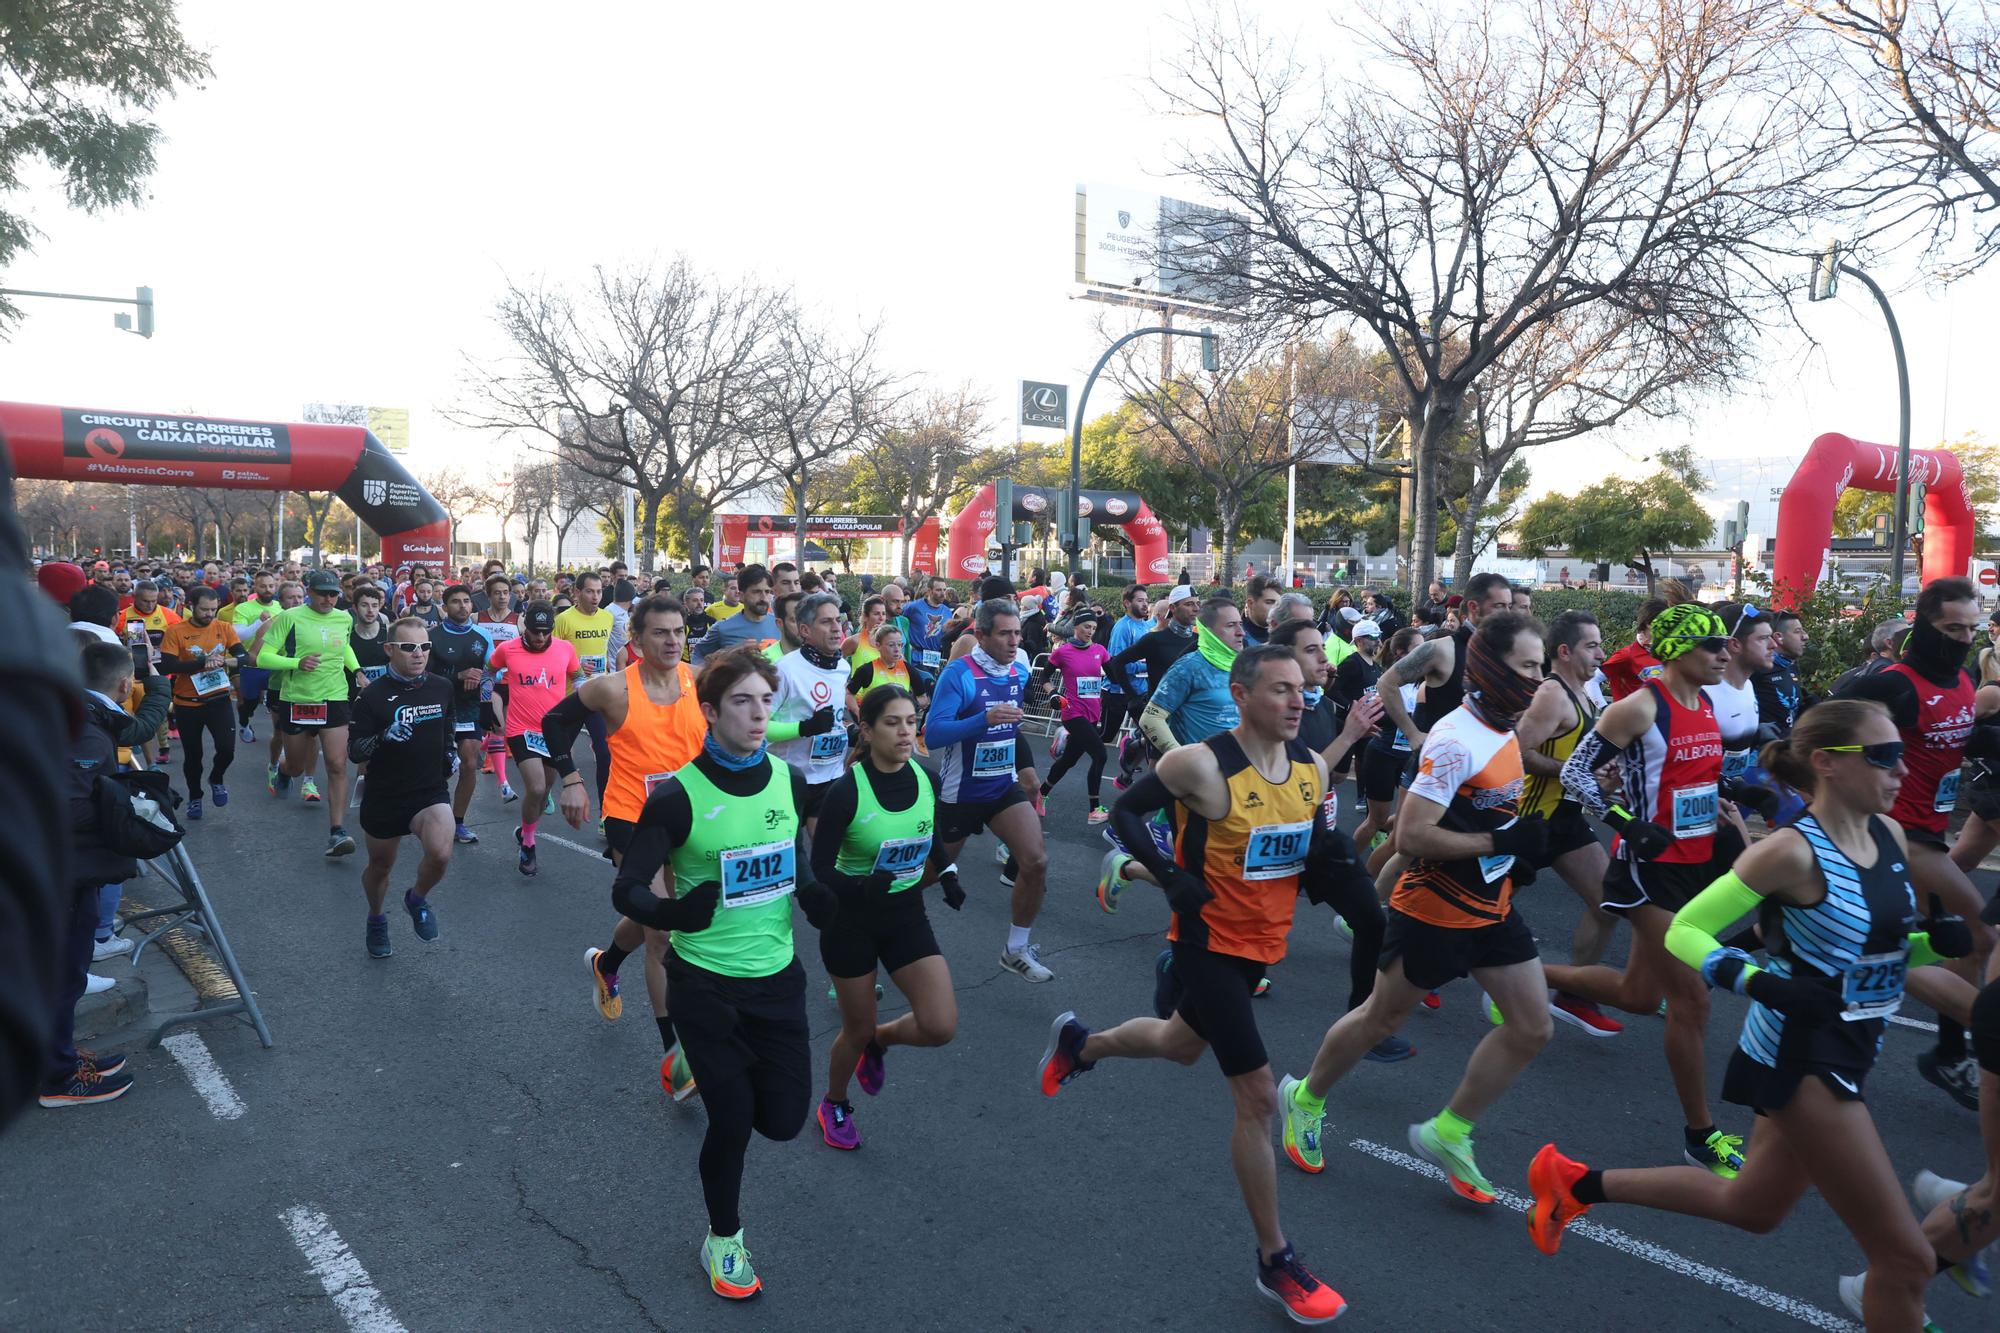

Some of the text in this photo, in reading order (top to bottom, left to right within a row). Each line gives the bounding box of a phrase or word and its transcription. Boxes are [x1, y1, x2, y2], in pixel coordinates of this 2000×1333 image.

[1106, 232, 1141, 244] PEUGEOT
[80, 414, 272, 436] CIRCUIT DE CARRERES
[1026, 413, 1065, 425] LEXUS
[87, 463, 194, 477] #ValènciaCorre
[1670, 735, 1693, 747] CLUB
[982, 747, 1009, 763] 2381
[1259, 833, 1303, 857] 2197
[887, 844, 923, 864] 2107
[736, 854, 782, 883] 2412
